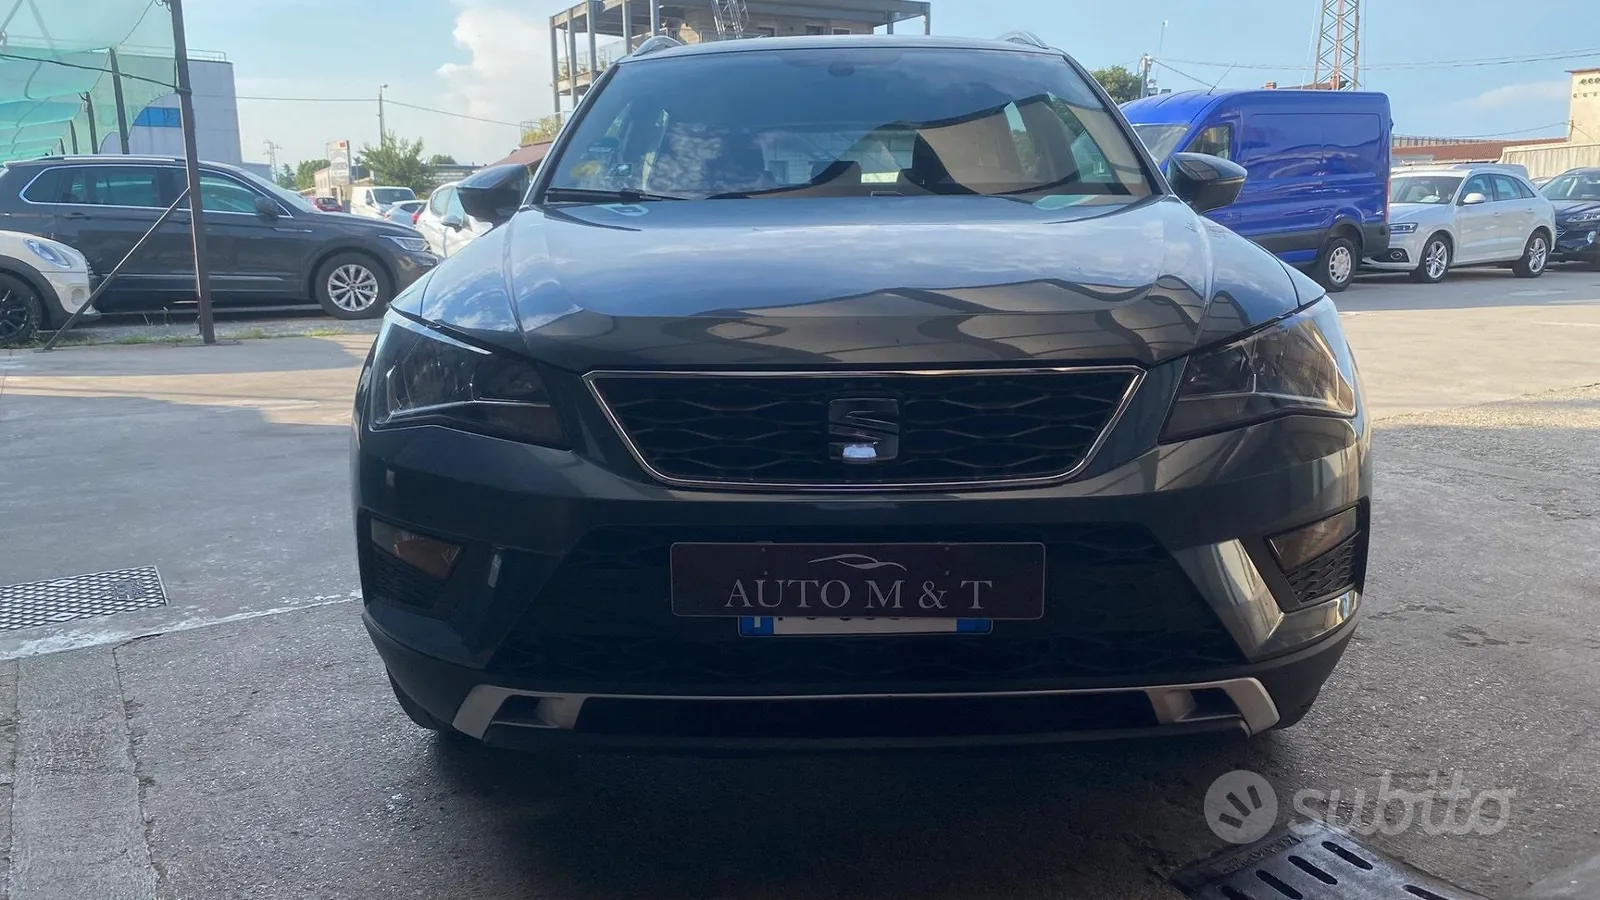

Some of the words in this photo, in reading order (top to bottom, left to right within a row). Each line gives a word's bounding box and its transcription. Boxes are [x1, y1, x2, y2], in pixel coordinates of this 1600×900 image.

[724, 578, 851, 609] AUTO
[865, 579, 904, 610] M
[918, 579, 948, 610] &
[960, 579, 993, 610] T
